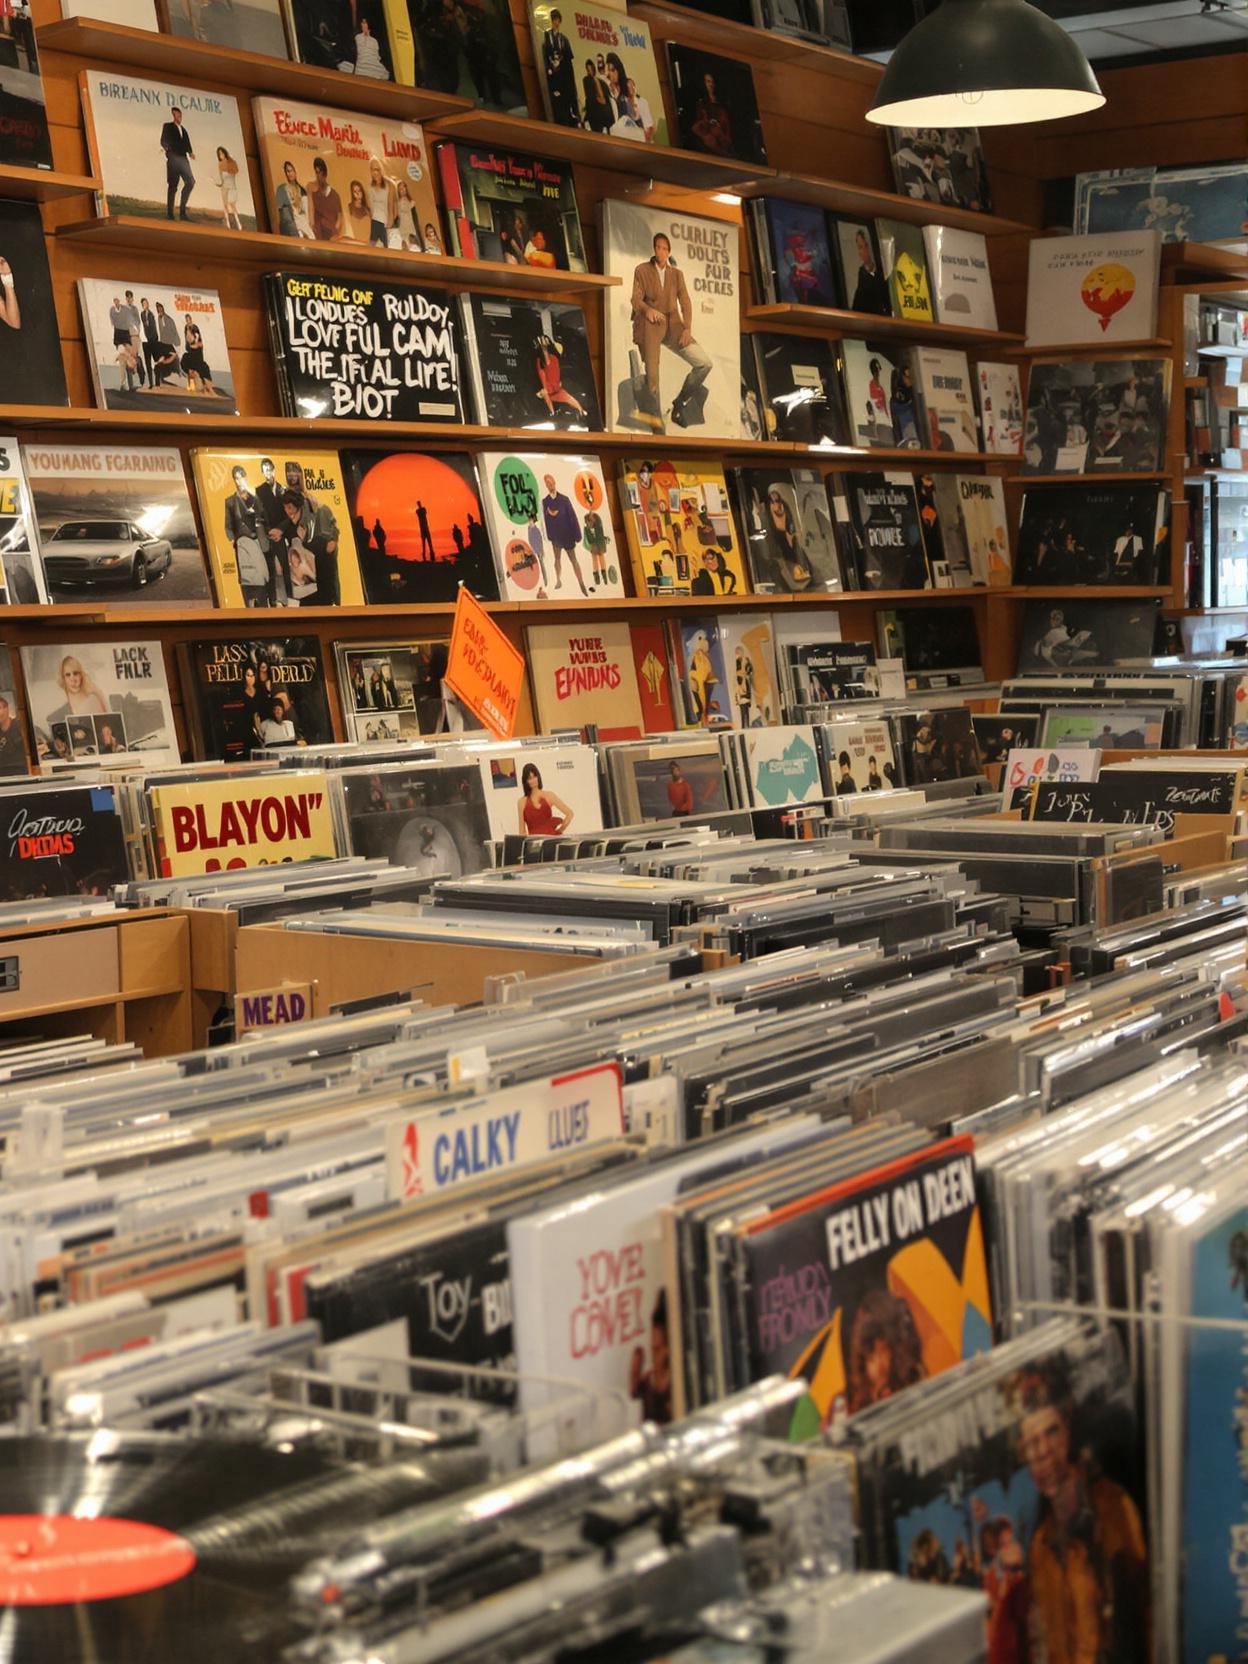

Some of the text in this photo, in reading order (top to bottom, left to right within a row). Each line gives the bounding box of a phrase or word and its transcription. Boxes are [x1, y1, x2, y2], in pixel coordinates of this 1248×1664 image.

[243, 992, 306, 1028] MEAD
[433, 1111, 522, 1187] CALKY
[825, 1192, 891, 1271] FELLY
[892, 1180, 924, 1240] ON
